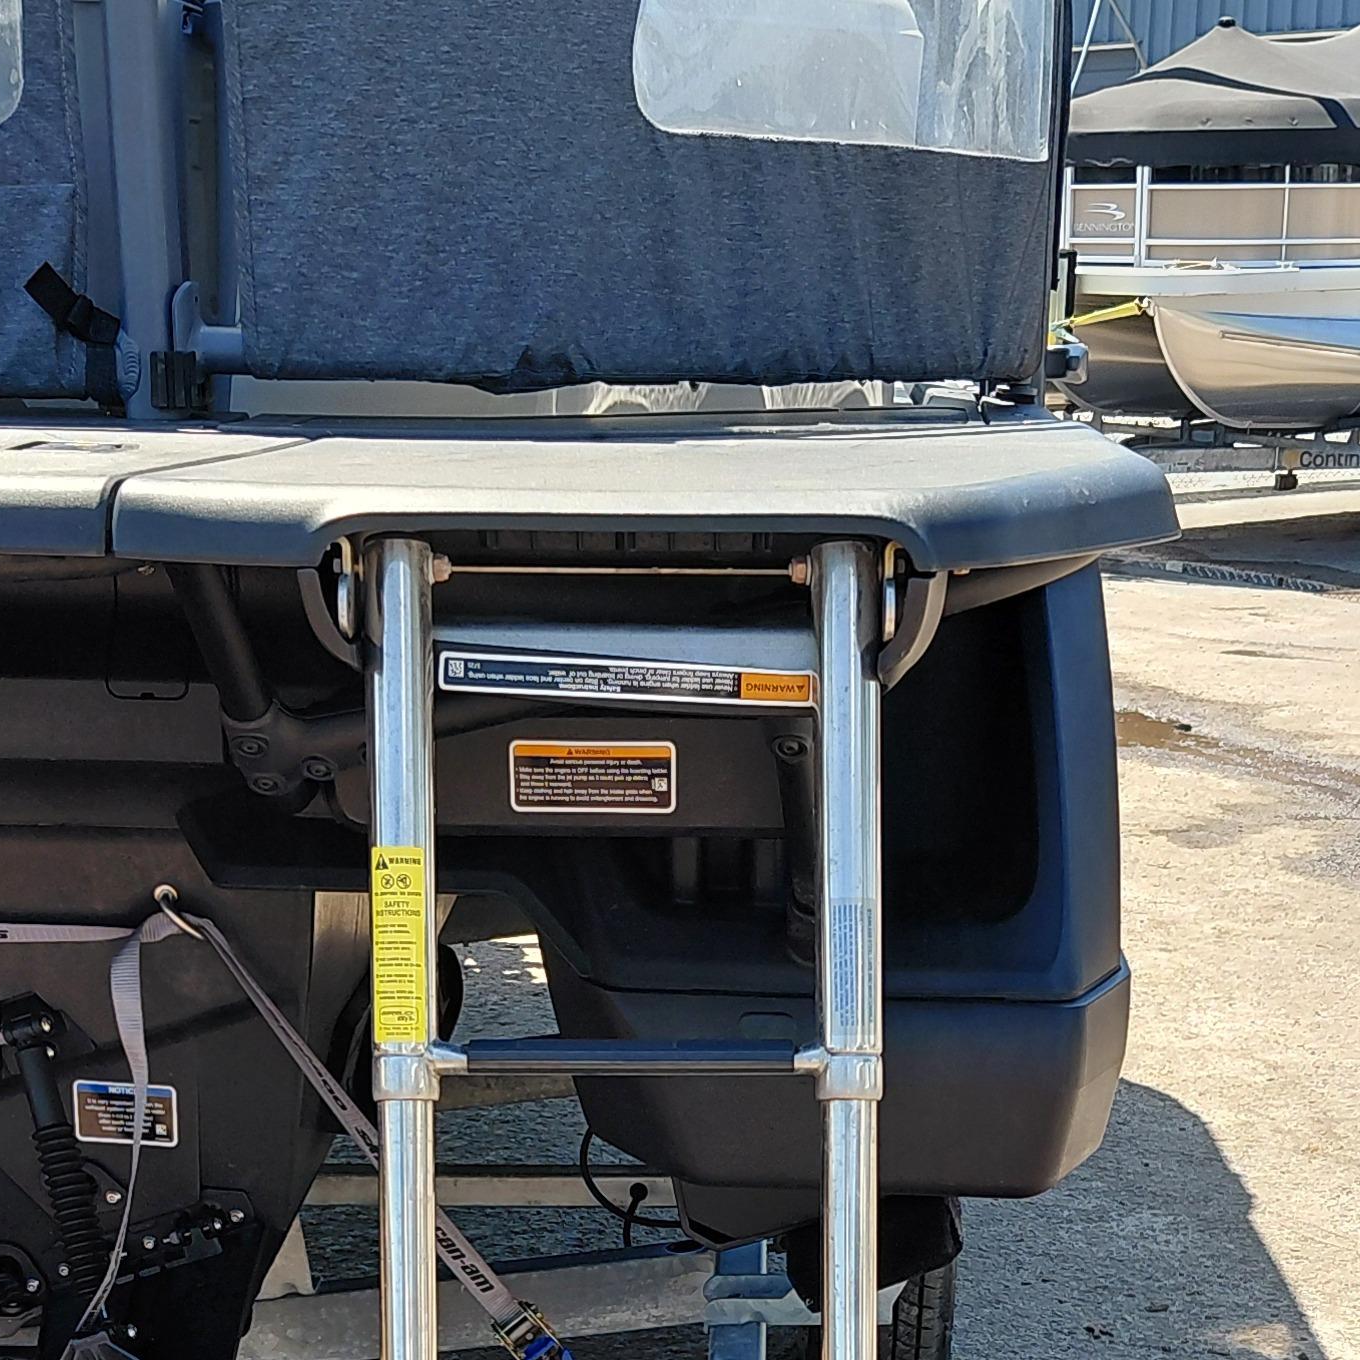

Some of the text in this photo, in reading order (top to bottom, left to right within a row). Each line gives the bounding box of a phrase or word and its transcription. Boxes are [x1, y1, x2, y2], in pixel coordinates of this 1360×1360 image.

[1075, 222, 1134, 232] ENNINGTO
[745, 682, 796, 693] WARNING
[384, 900, 410, 908] SAFETY
[108, 1086, 137, 1095] NOTIC
[435, 1226, 495, 1294] can-am
